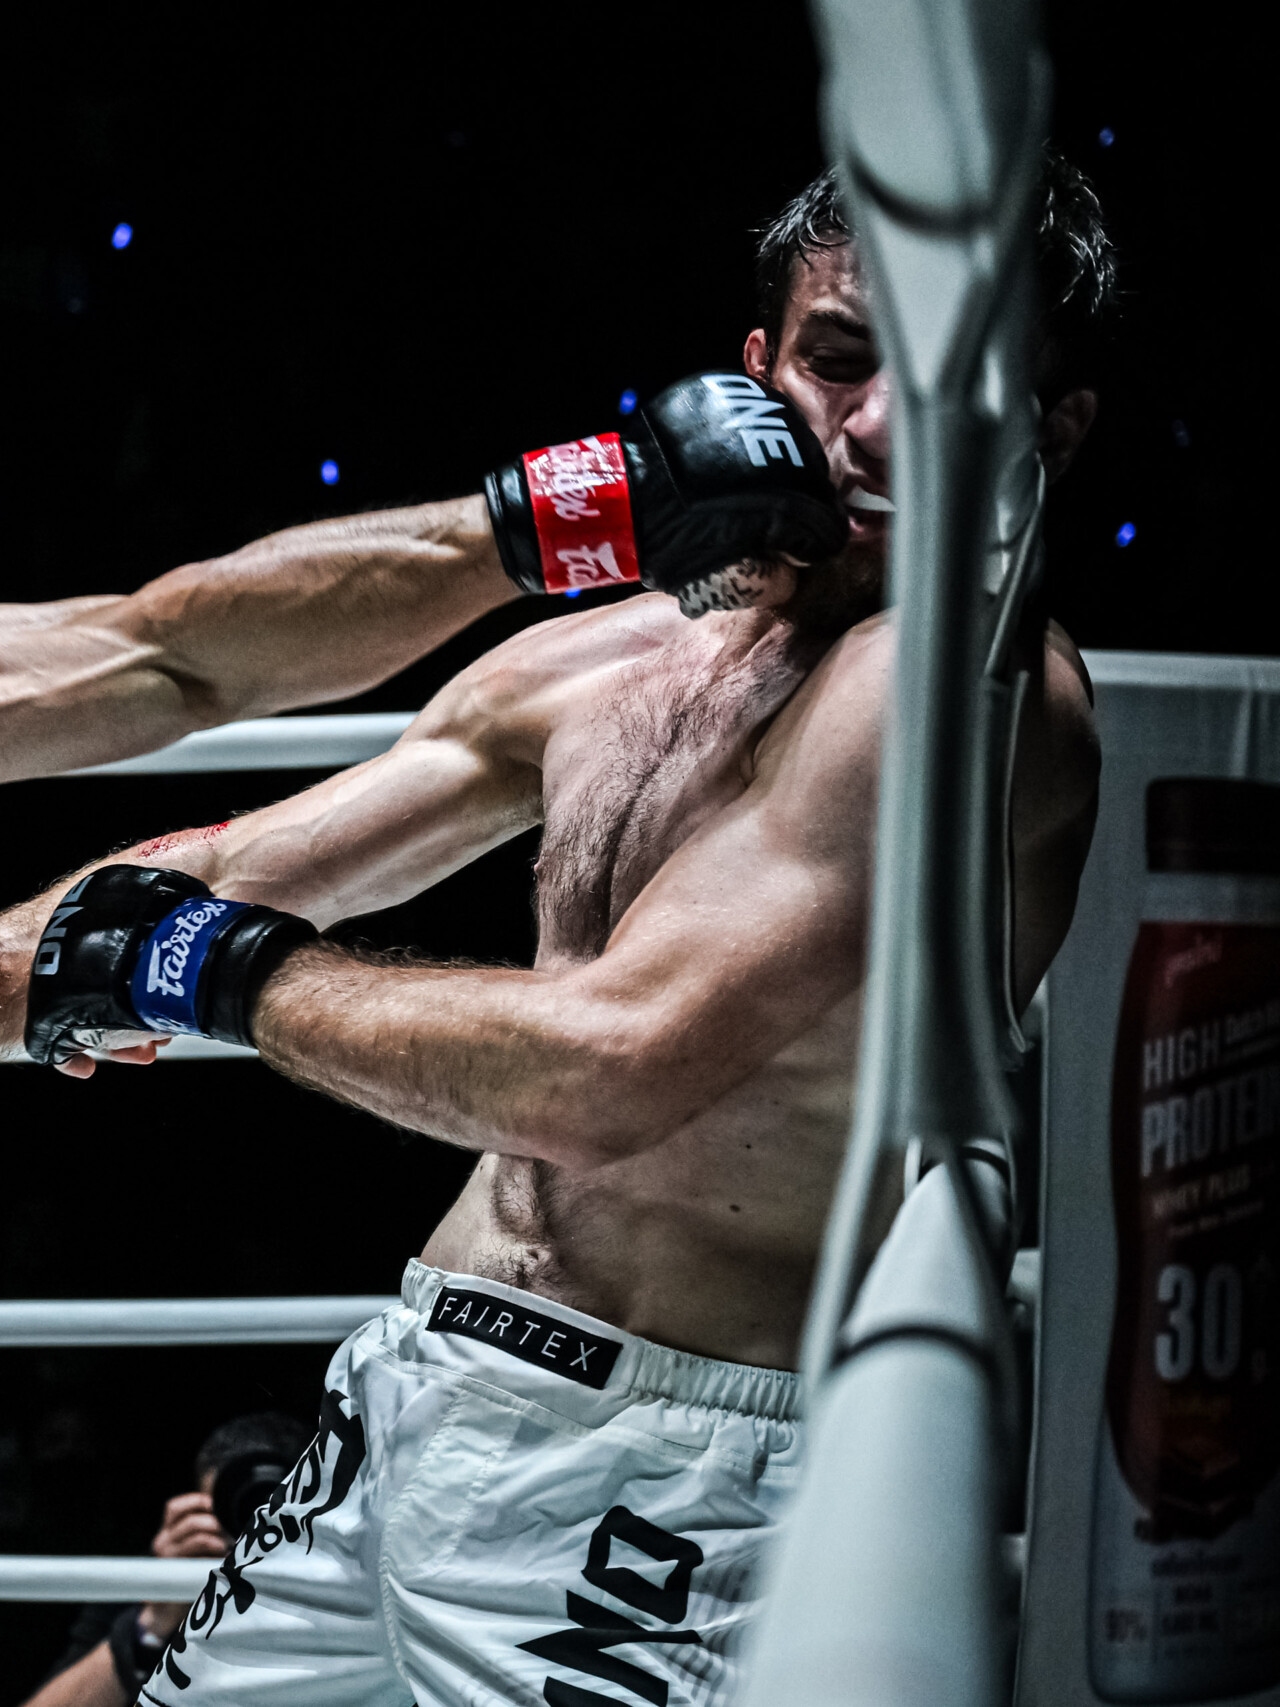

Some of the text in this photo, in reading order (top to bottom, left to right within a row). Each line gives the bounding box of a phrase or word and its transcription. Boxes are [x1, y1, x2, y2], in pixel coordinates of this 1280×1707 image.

[701, 374, 804, 468] ONE
[146, 901, 228, 998] Fairtex
[1143, 1016, 1222, 1092] HIGH
[437, 1296, 599, 1372] FAIRTEX
[1154, 1261, 1244, 1384] 30
[514, 1505, 704, 1707] ON
